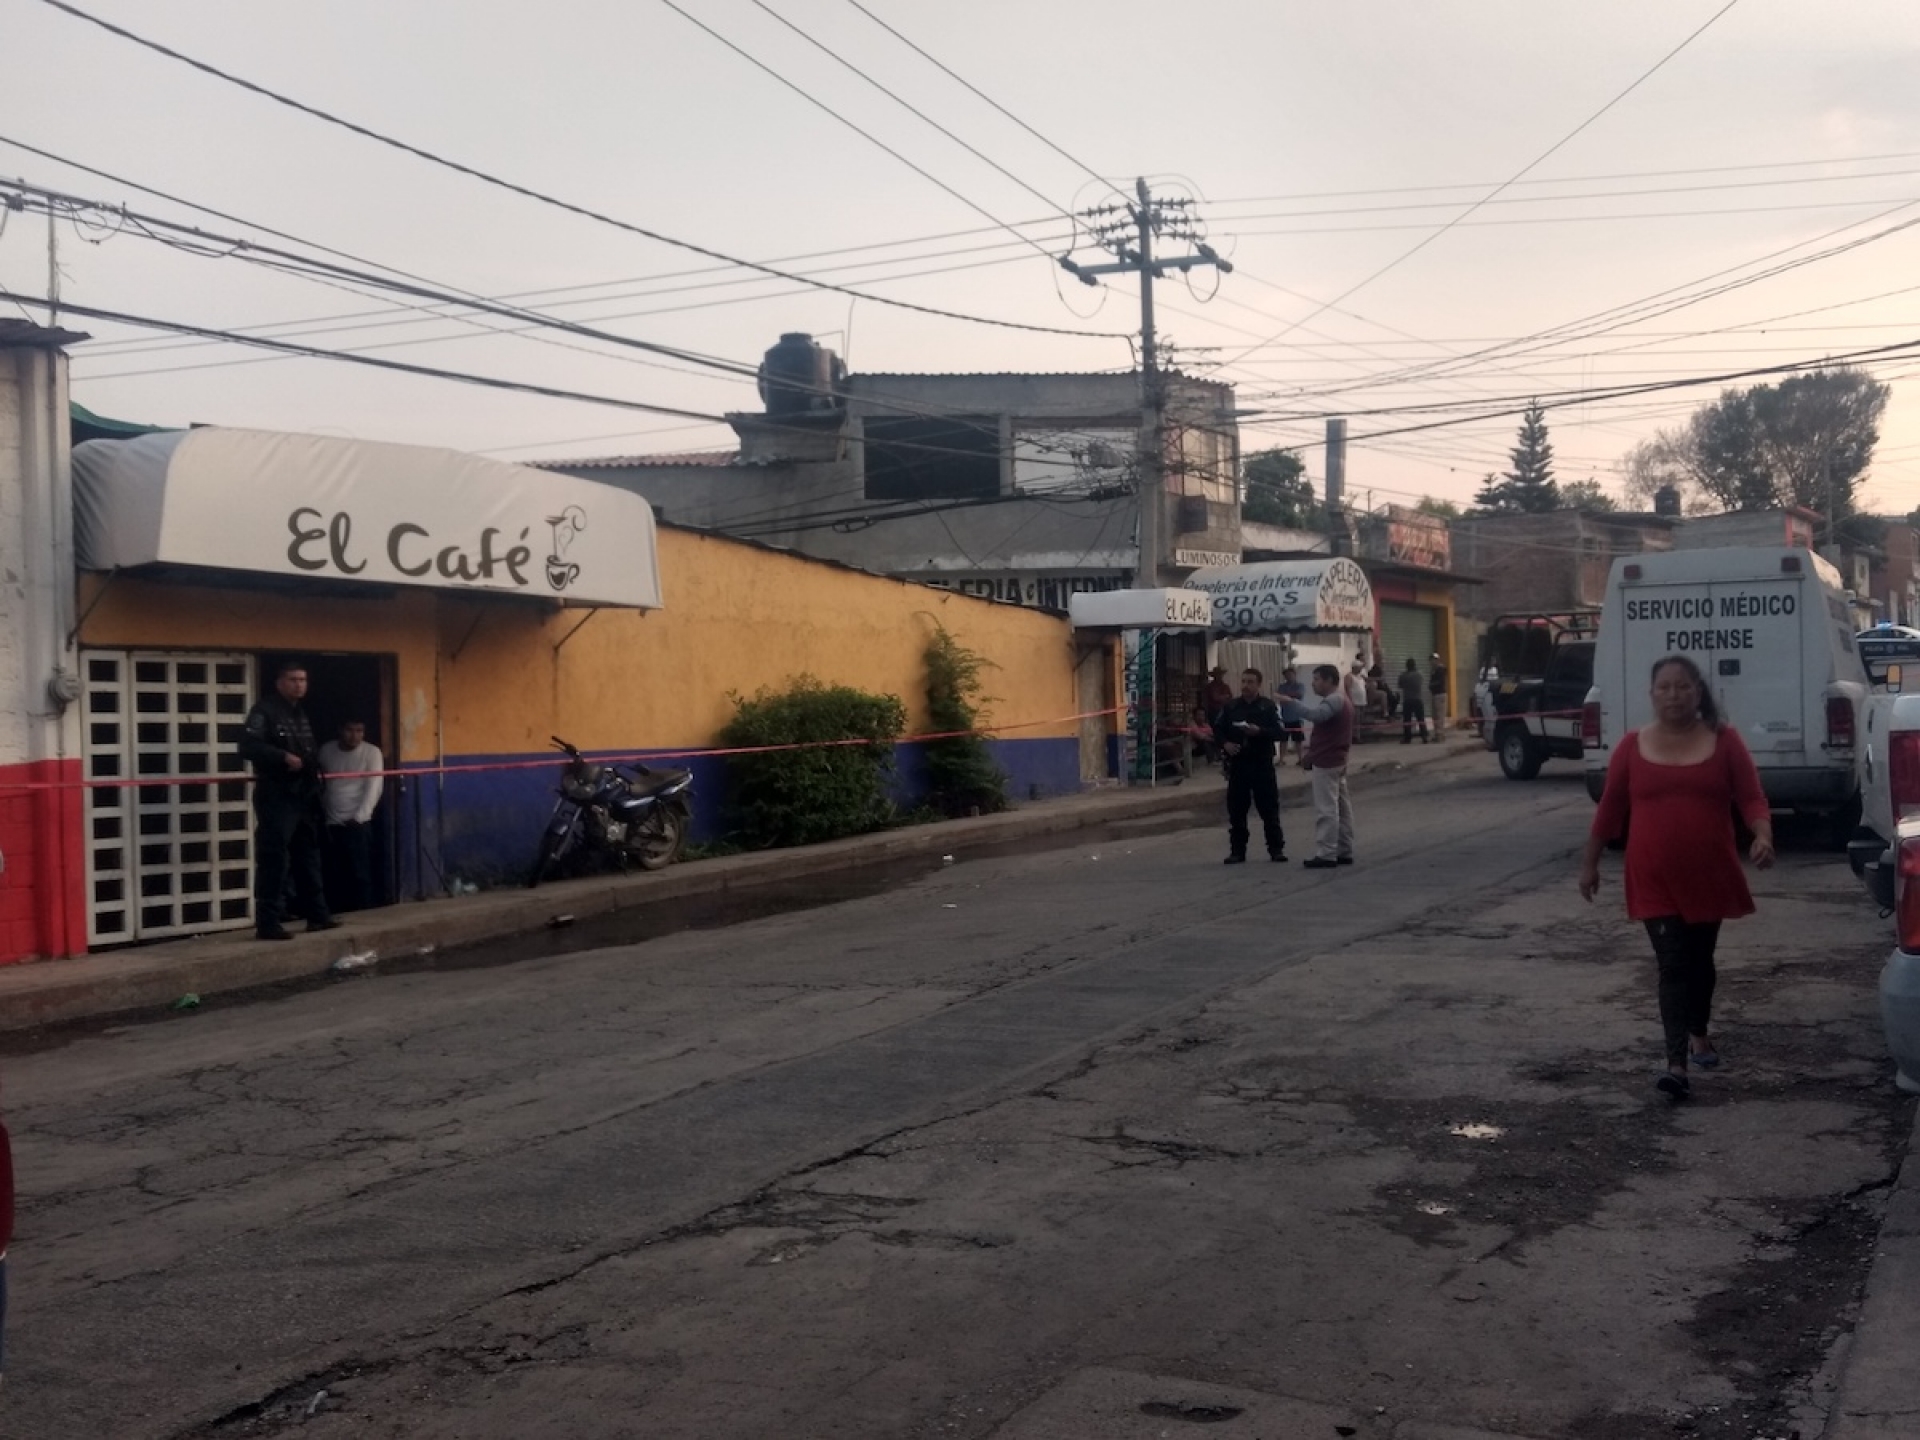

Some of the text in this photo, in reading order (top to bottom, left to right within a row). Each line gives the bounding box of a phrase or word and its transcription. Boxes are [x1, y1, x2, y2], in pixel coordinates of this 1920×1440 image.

[288, 507, 531, 585] El Café
[1175, 550, 1238, 566] LUMINOSOS
[1259, 573, 1323, 590] Internet
[1166, 598, 1177, 620] El
[1213, 591, 1299, 609] OPIAS
[1627, 591, 1796, 620] SERVICIO MÉDICO
[1221, 607, 1254, 628] 30
[1666, 629, 1753, 650] FORENSE
